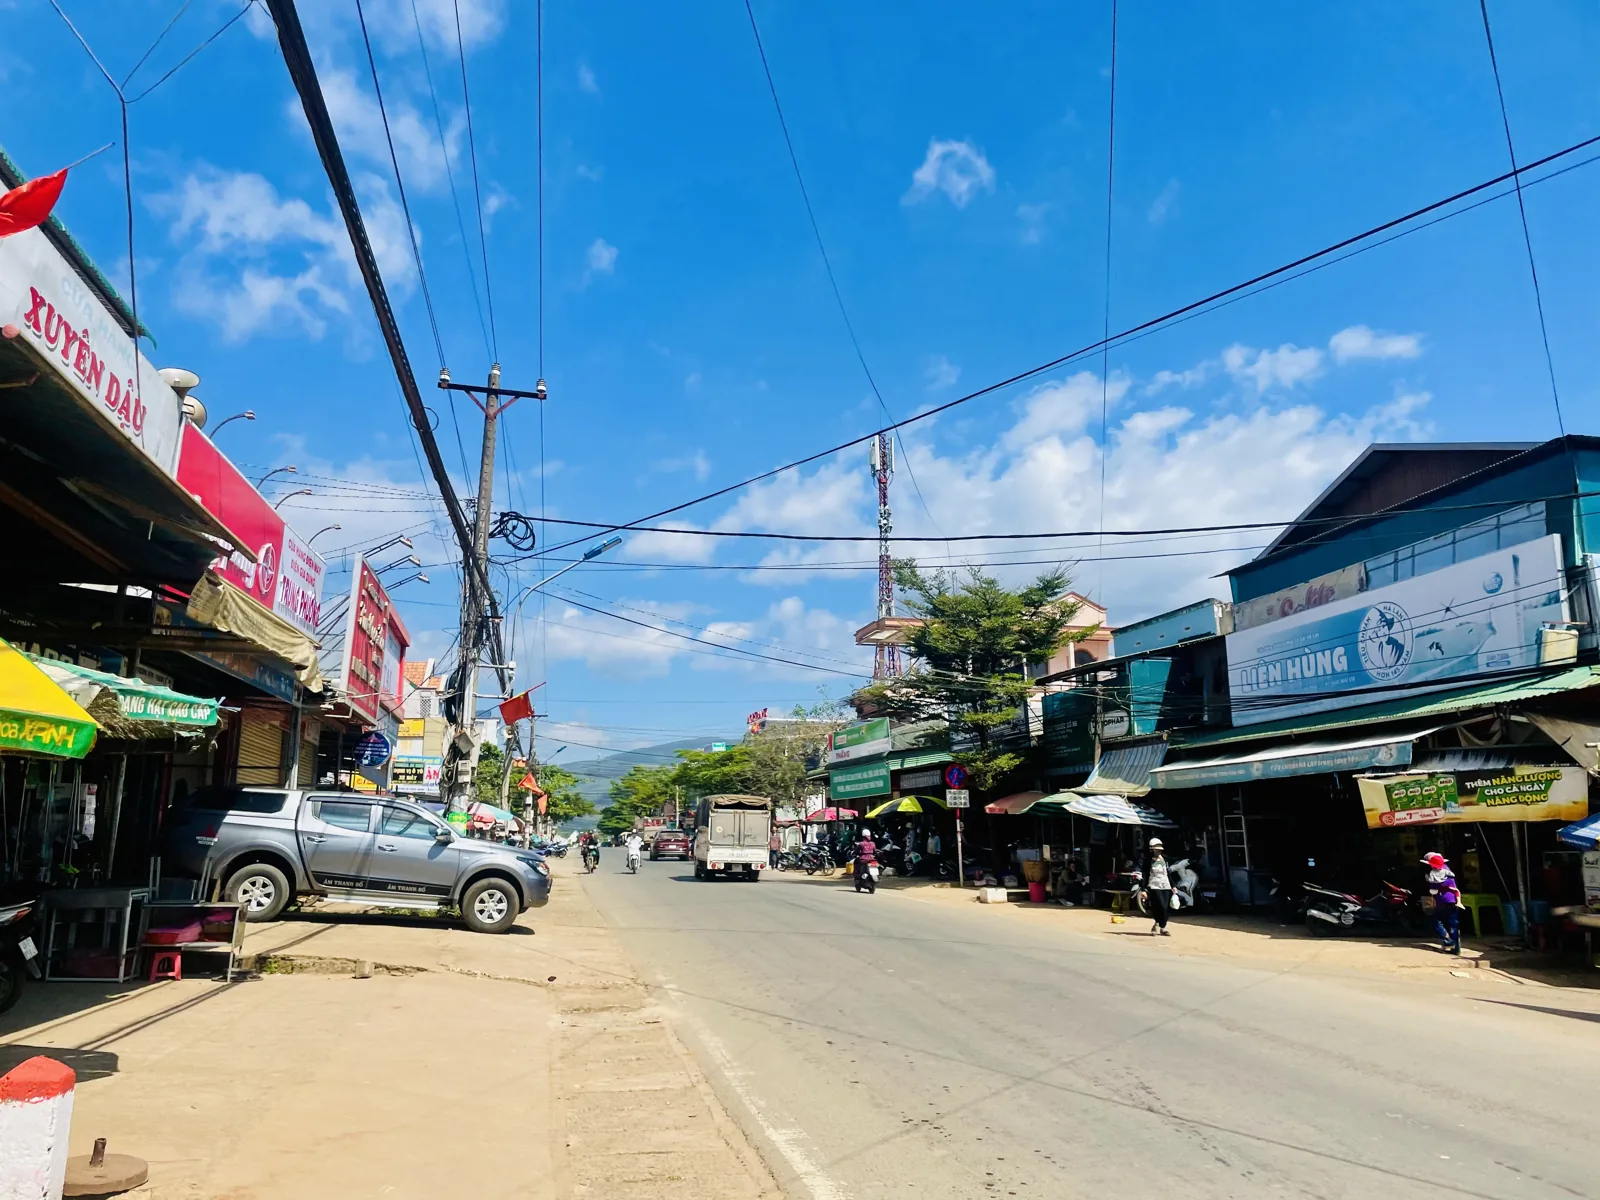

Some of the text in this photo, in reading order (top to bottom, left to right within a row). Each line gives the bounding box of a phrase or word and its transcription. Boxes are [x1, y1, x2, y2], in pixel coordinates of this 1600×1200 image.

[24, 286, 105, 397] XUYÊN
[1240, 658, 1282, 694] LIÊN
[1286, 646, 1349, 684] HÙNG
[0, 719, 76, 748] oa XANH
[1464, 778, 1491, 789] THÊM
[1524, 771, 1562, 783] LƯỢNG
[1484, 788, 1504, 796] CHO
[1519, 782, 1546, 792] NGÀY
[1406, 812, 1412, 820] 7
